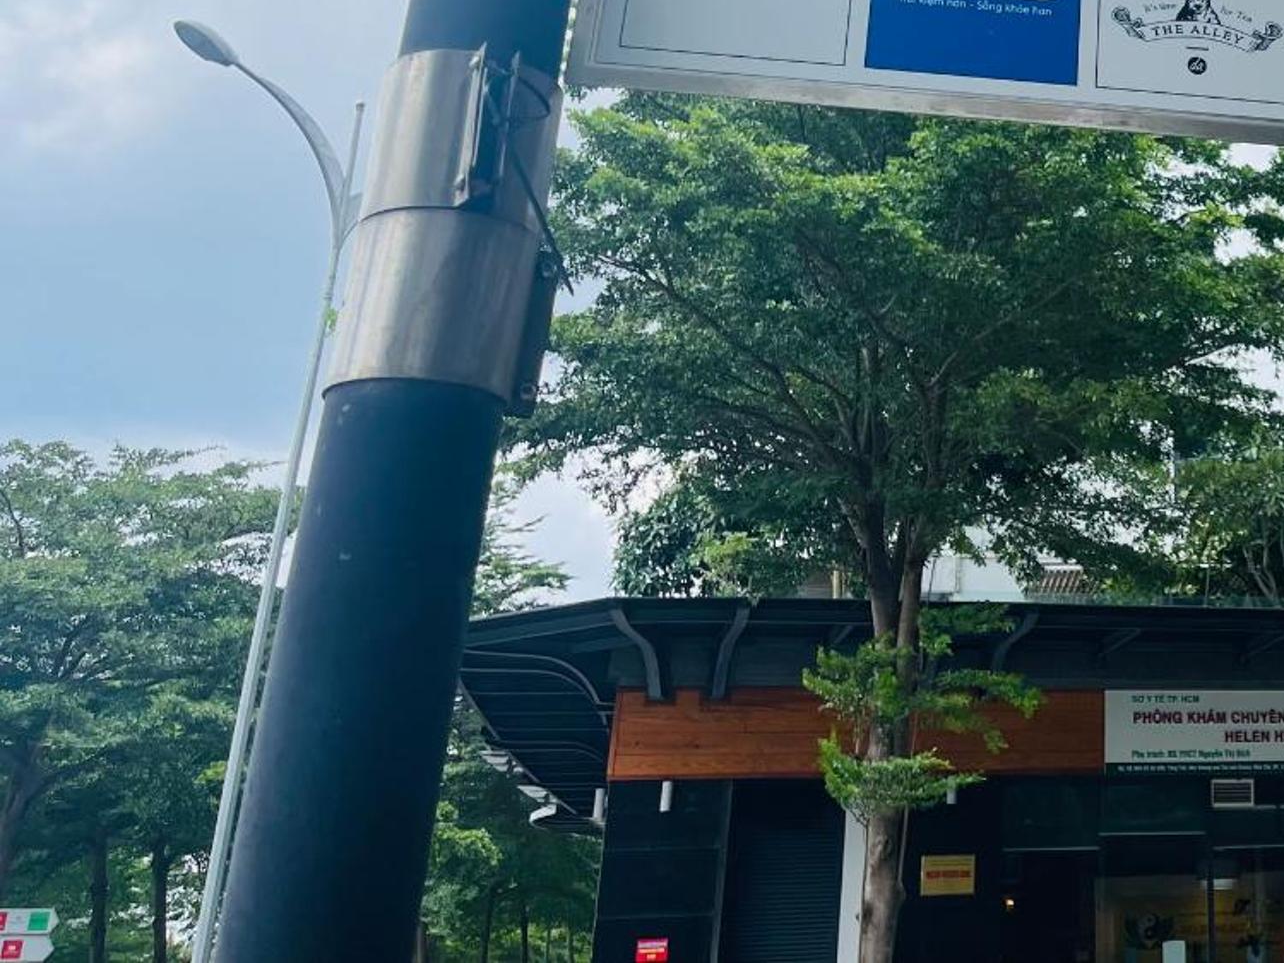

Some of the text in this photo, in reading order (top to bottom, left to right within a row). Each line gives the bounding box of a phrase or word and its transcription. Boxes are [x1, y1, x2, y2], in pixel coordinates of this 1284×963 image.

[1151, 24, 1245, 44] THE ALLEY
[1225, 730, 1271, 743] HELEN
